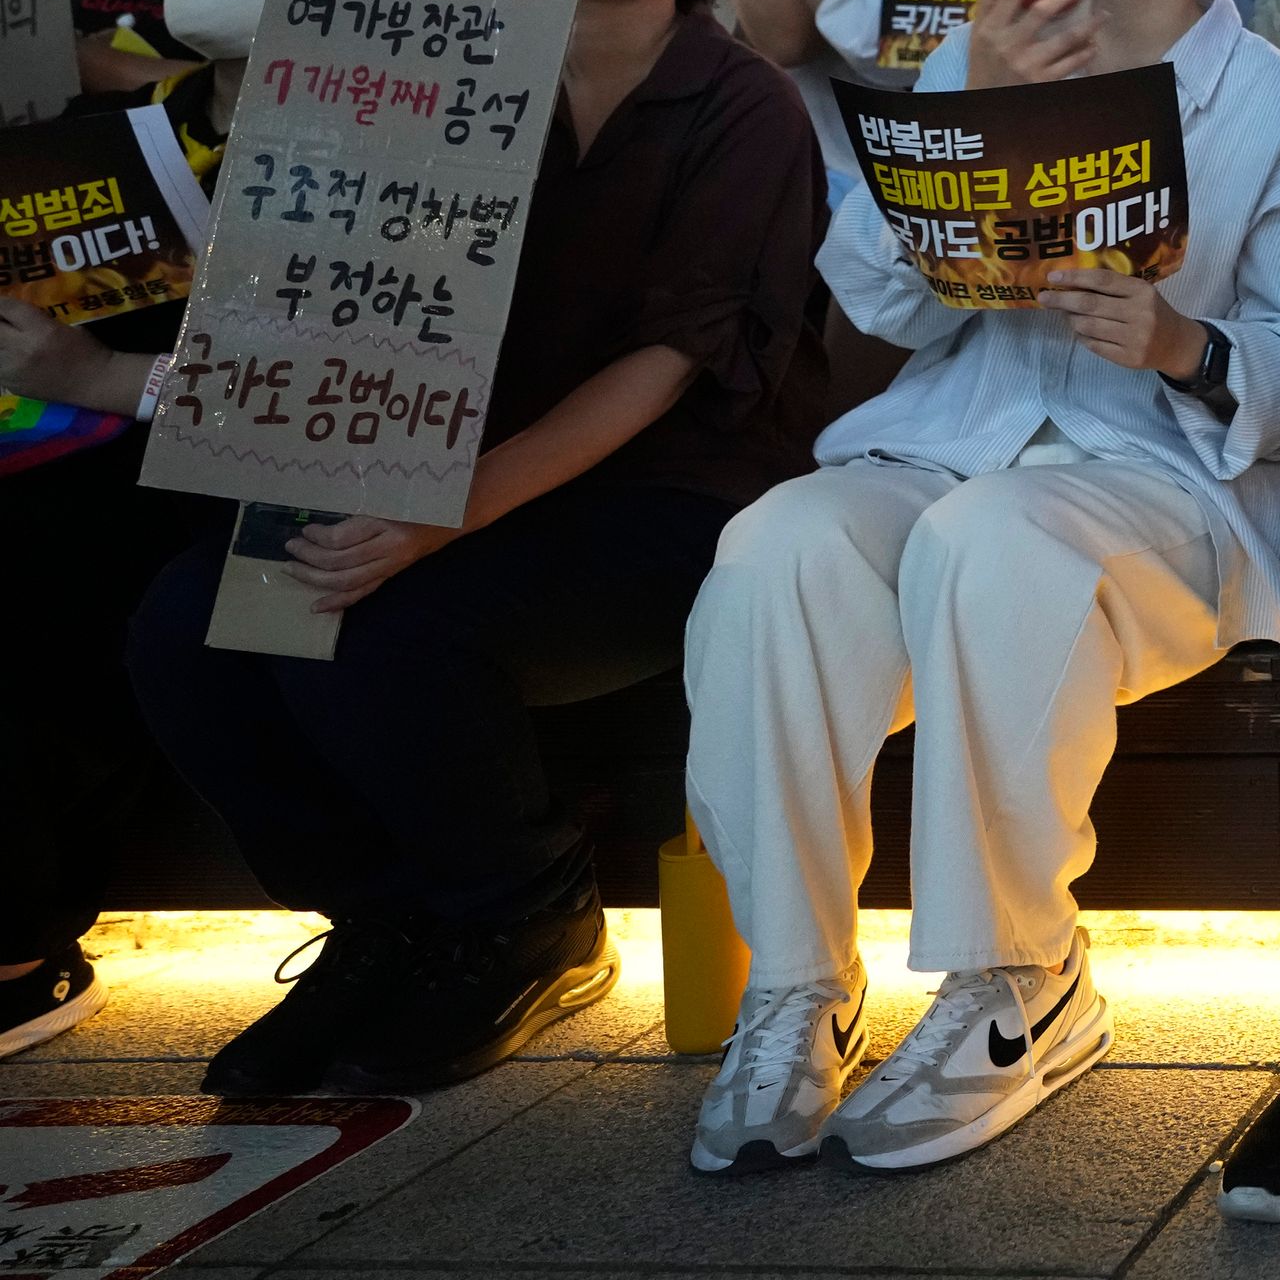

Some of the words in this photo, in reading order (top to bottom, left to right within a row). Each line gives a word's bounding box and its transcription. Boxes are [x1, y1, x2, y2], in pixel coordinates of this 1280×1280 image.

[444, 78, 529, 150] 공석
[858, 113, 984, 162] 반복되는
[0, 176, 126, 236] 성범죄
[242, 154, 368, 234] 구조적
[380, 179, 520, 266] 성차별
[874, 163, 1012, 211] 딥페이크
[1025, 139, 1151, 208] 성범죄
[889, 210, 982, 260] 국가도
[994, 187, 1171, 262] 공범이다!
[80, 278, 172, 312] 공동행동
[276, 252, 453, 344] 부정하는
[976, 282, 1035, 301] 성범죄
[175, 333, 296, 426] 국가도
[305, 358, 480, 449] 공범이다
